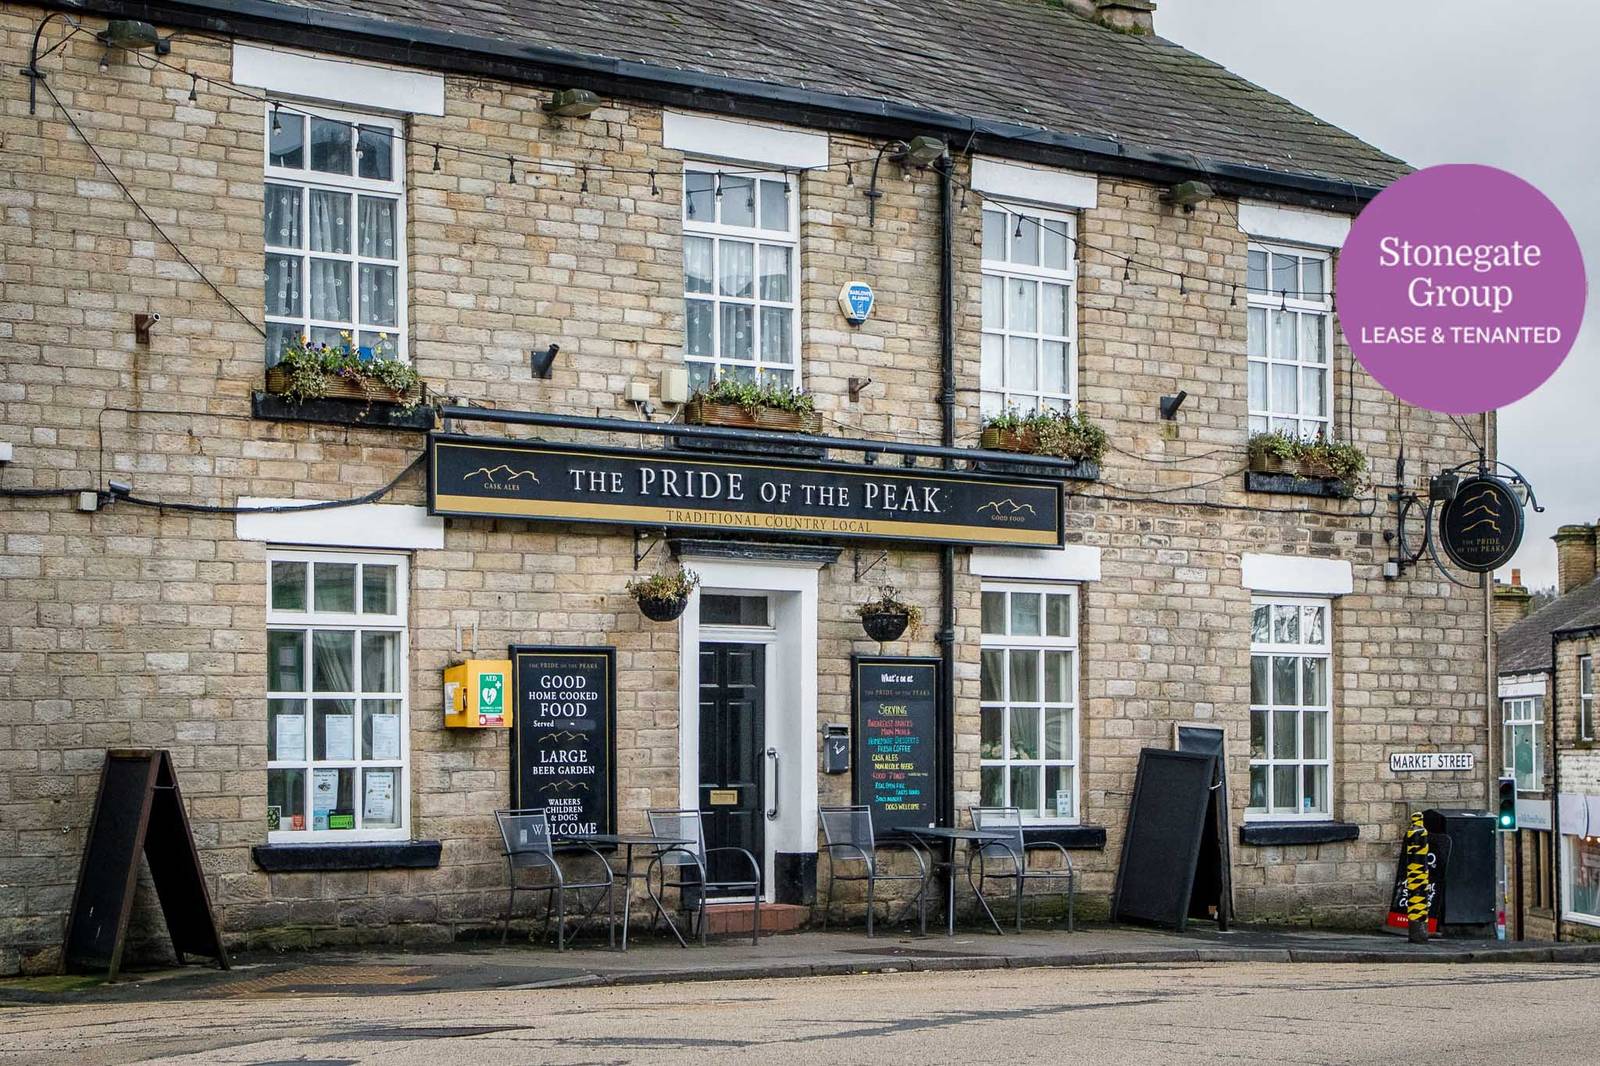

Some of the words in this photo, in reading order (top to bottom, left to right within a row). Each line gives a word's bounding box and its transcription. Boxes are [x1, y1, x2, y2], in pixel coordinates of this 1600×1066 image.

[484, 482, 502, 490] CASK
[503, 483, 520, 491] ALES
[569, 468, 625, 493] THE
[640, 467, 745, 500] PRIDE
[761, 481, 792, 504] OF
[801, 484, 850, 507] THE
[864, 482, 942, 513] PEAK
[666, 509, 759, 526] TRADITIONAL
[765, 515, 827, 531] COUNTRY
[832, 519, 872, 533] LOCAL
[991, 513, 1008, 521] GOOD
[541, 675, 586, 689] GOOD
[529, 691, 557, 700] HOME
[559, 691, 598, 701] COOKED
[540, 702, 587, 717] FOOD
[533, 719, 555, 728] Served
[540, 749, 588, 763] LARGE
[1393, 755, 1433, 768] MARKET
[1437, 754, 1472, 768] STREET
[533, 766, 556, 775] BEER
[558, 765, 596, 775] GARDEN
[548, 798, 581, 806] WALKERS
[545, 806, 583, 814] CHILDREN
[532, 822, 598, 836] WELCOME
